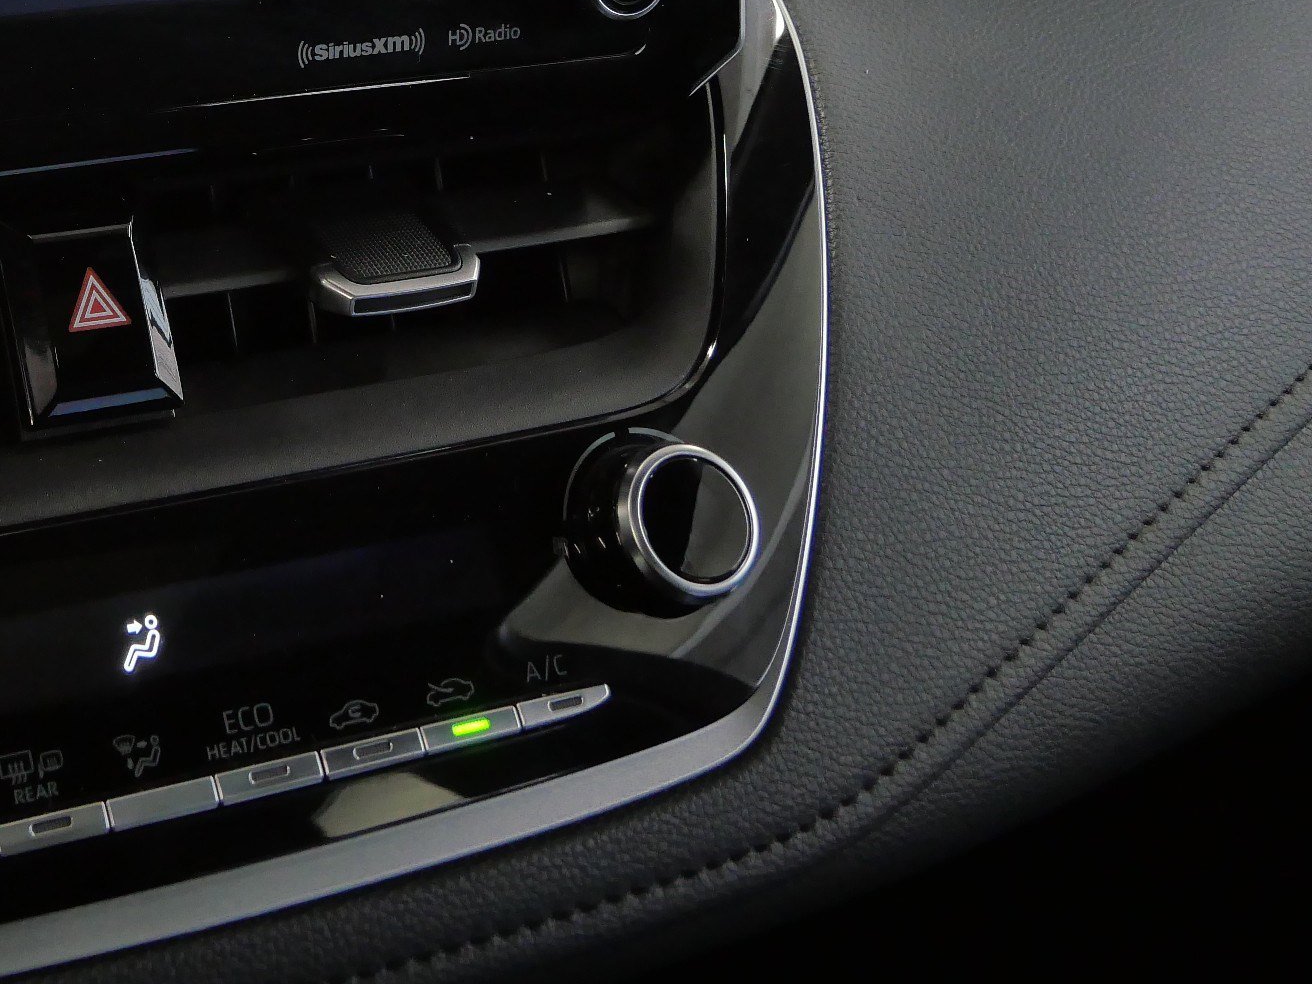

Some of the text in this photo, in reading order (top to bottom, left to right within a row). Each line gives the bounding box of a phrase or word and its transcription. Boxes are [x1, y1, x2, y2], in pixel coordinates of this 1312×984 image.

[475, 24, 521, 44] Radio
[526, 654, 568, 683] A/C
[223, 702, 274, 734] ECO
[206, 727, 301, 761] HEAT/COOL
[13, 781, 59, 805] REAR
